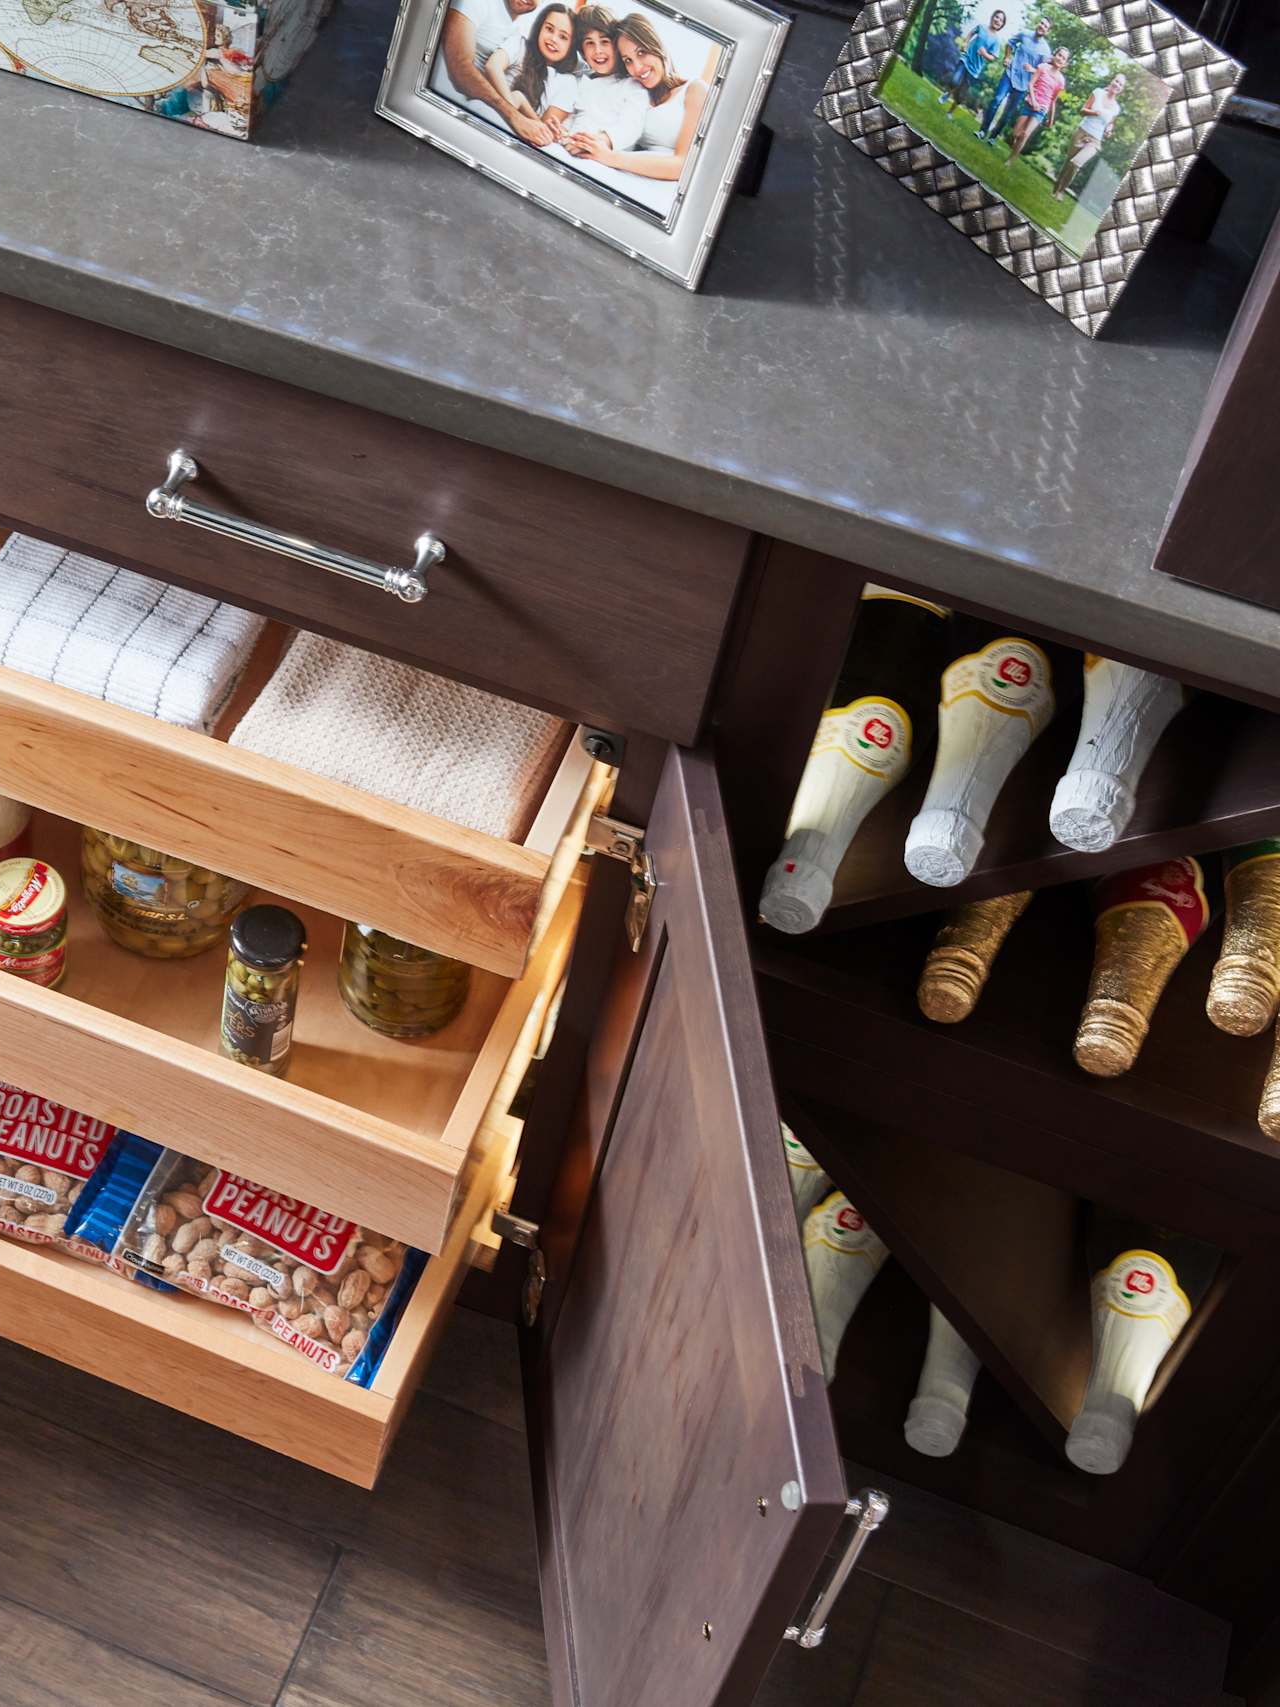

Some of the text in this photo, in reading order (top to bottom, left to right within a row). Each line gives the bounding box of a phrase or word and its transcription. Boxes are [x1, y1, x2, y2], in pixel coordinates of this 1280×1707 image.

[7, 1179, 18, 1191] WT
[24, 1184, 34, 1196] OZ
[33, 1187, 55, 1203] (227g)
[213, 1182, 338, 1262] PEANUTS
[63, 1239, 122, 1270] EANUTS
[223, 1248, 237, 1260] NET
[236, 1254, 248, 1266] WT
[252, 1262, 262, 1273] OZ
[274, 1317, 339, 1370] PEANUTS
